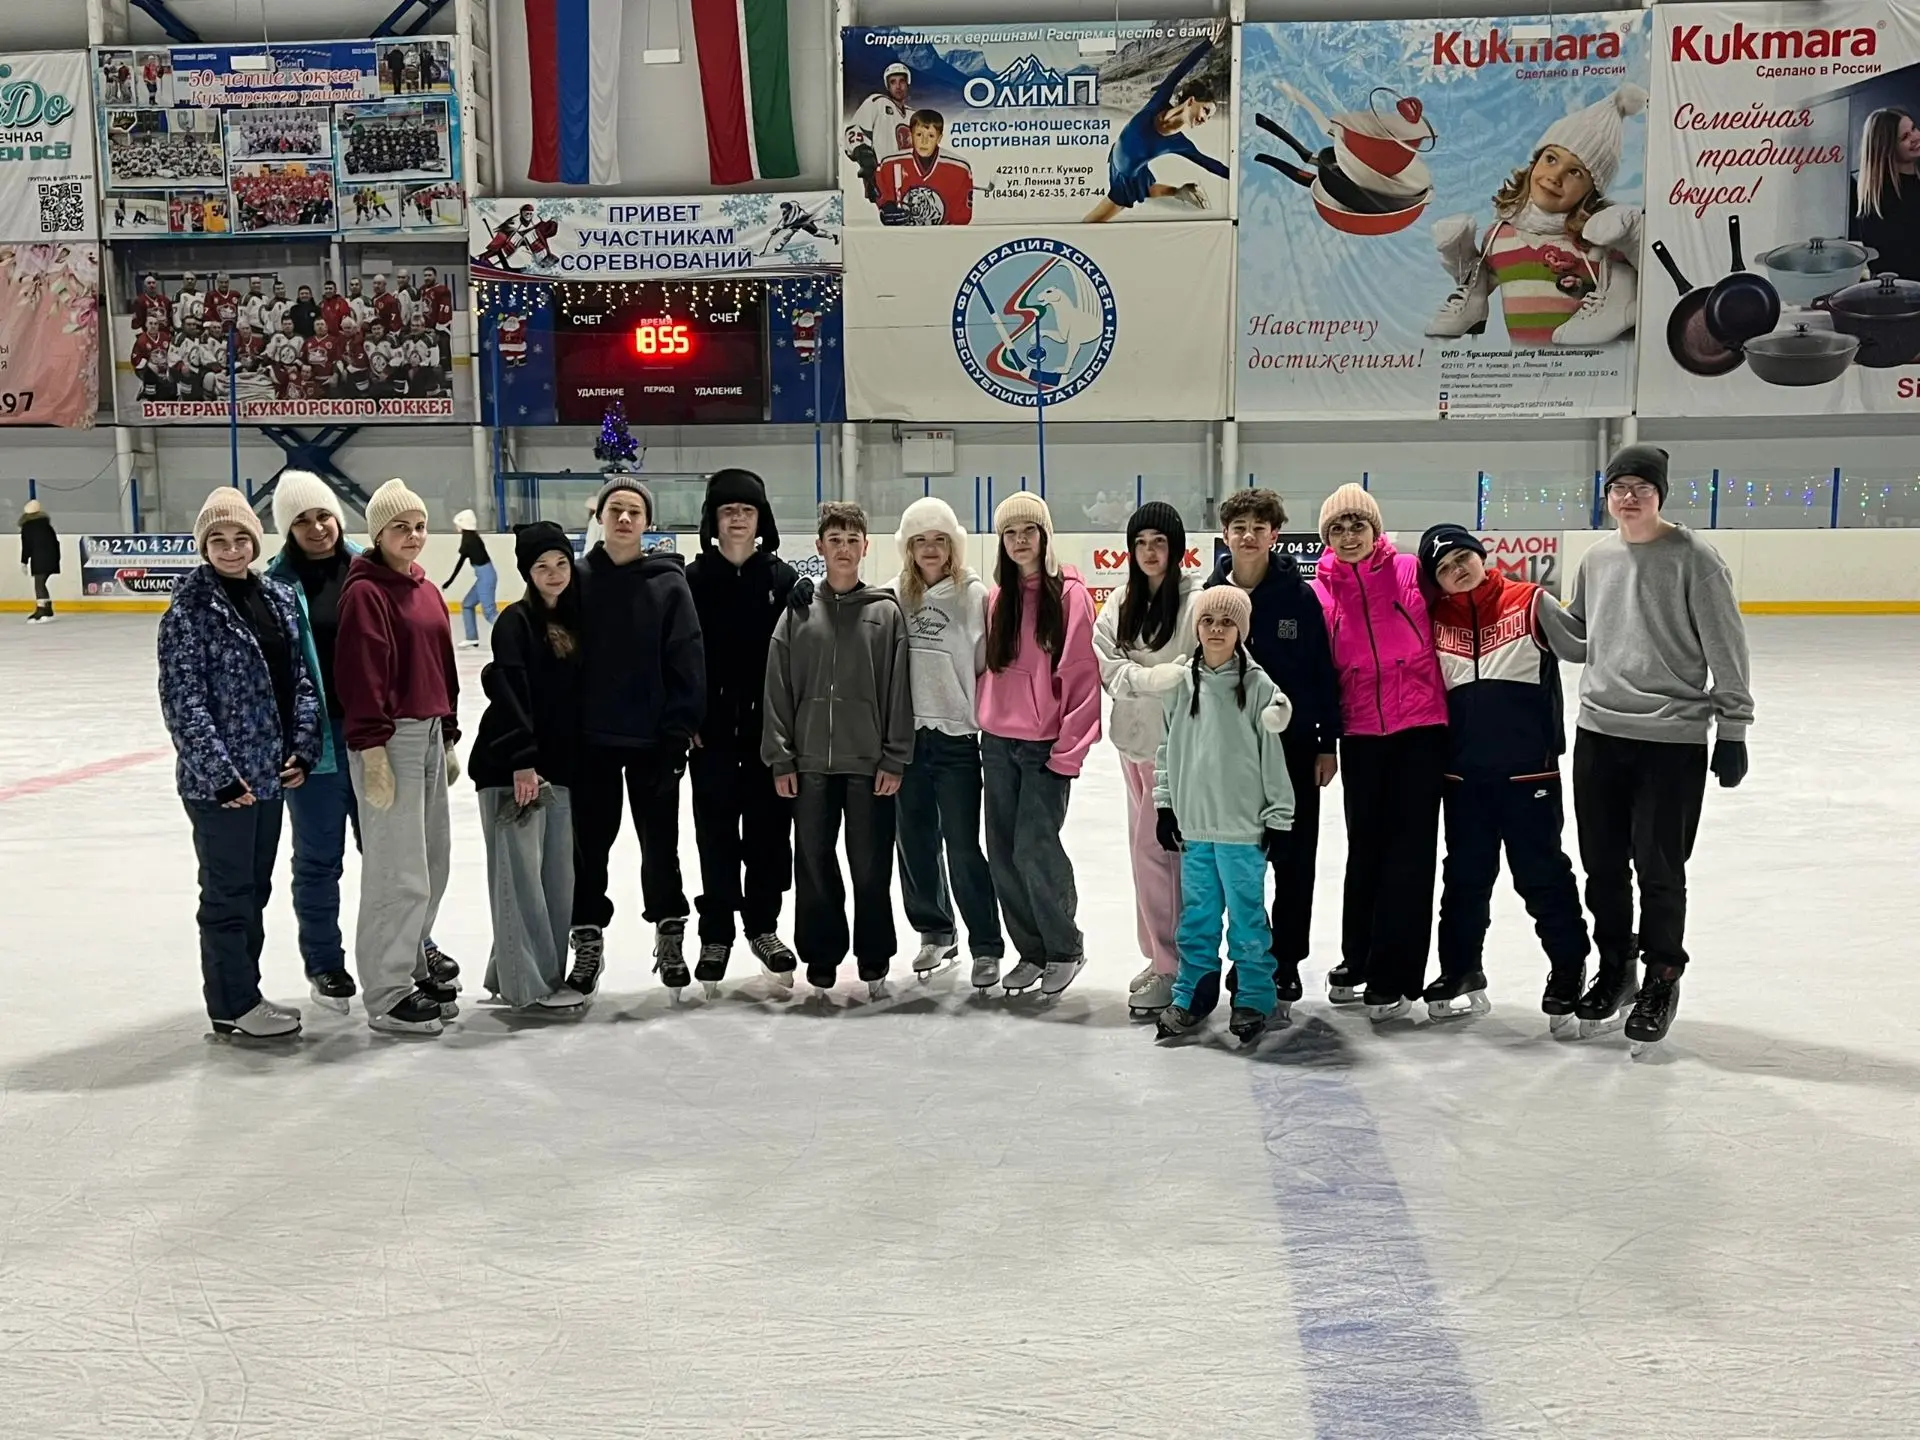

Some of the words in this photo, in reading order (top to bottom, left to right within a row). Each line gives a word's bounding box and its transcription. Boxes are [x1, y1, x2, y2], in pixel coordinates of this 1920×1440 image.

[865, 32, 949, 47] Стремимся
[952, 36, 962, 44] к
[964, 28, 1043, 46] вершинам!
[1167, 28, 1175, 37] с
[1671, 22, 1877, 65] Kukmara
[188, 69, 285, 87] 50-летие
[290, 68, 361, 85] хоккея
[1516, 68, 1568, 80] Сделано
[1572, 69, 1579, 77] в
[1583, 66, 1626, 77] России
[1756, 65, 1816, 79] Сделано
[1820, 66, 1828, 75] в
[1833, 63, 1882, 75] России
[190, 89, 300, 108] Кукморского
[300, 86, 363, 105] района
[1673, 102, 1815, 131] Семейная
[950, 118, 1111, 135] детско-юношеская
[951, 135, 1050, 149] спортивная
[1056, 134, 1109, 145] школа
[1696, 138, 1844, 175] традиция
[996, 165, 1030, 174] 422110
[1056, 165, 1094, 175] Кукмор
[1024, 177, 1061, 186] Ленина
[1063, 176, 1075, 185] 37
[1078, 176, 1086, 185] Б
[984, 190, 990, 198] 8
[992, 189, 1028, 200] (84364)
[1070, 188, 1105, 197] 2-67-44
[1669, 176, 1763, 219] вкуса!
[608, 204, 701, 223] ПРИВЕТ
[578, 227, 735, 248] УЧАСТНИКАМ
[560, 247, 753, 272] СОРЕВНОВАНИЙ
[957, 240, 1054, 310] ФЕДЕРАЦИЯ
[1061, 245, 1113, 306] ХОККЕЯ
[572, 314, 602, 325] СЧЕТ
[709, 312, 739, 323] СЧЕТ
[1247, 314, 1379, 342] Навстречу
[955, 327, 1038, 405] РЕСПУБЛИКИ
[1043, 326, 1115, 405] ТАТАРСТАН
[1248, 347, 1425, 375] достижениям!
[576, 387, 625, 397] УДАЛЕНИЕ
[643, 385, 675, 394] ПЕРИОД
[694, 386, 743, 396] УДАЛЕНИЕ
[247, 400, 375, 417] КУКМОРСКОГО
[380, 399, 453, 416] ХОККЕЯ
[87, 538, 197, 553] 892704370
[1287, 542, 1303, 554] 04
[1306, 542, 1322, 554] 37
[1481, 537, 1557, 553] САЛОН
[134, 579, 174, 590] KUKMO
